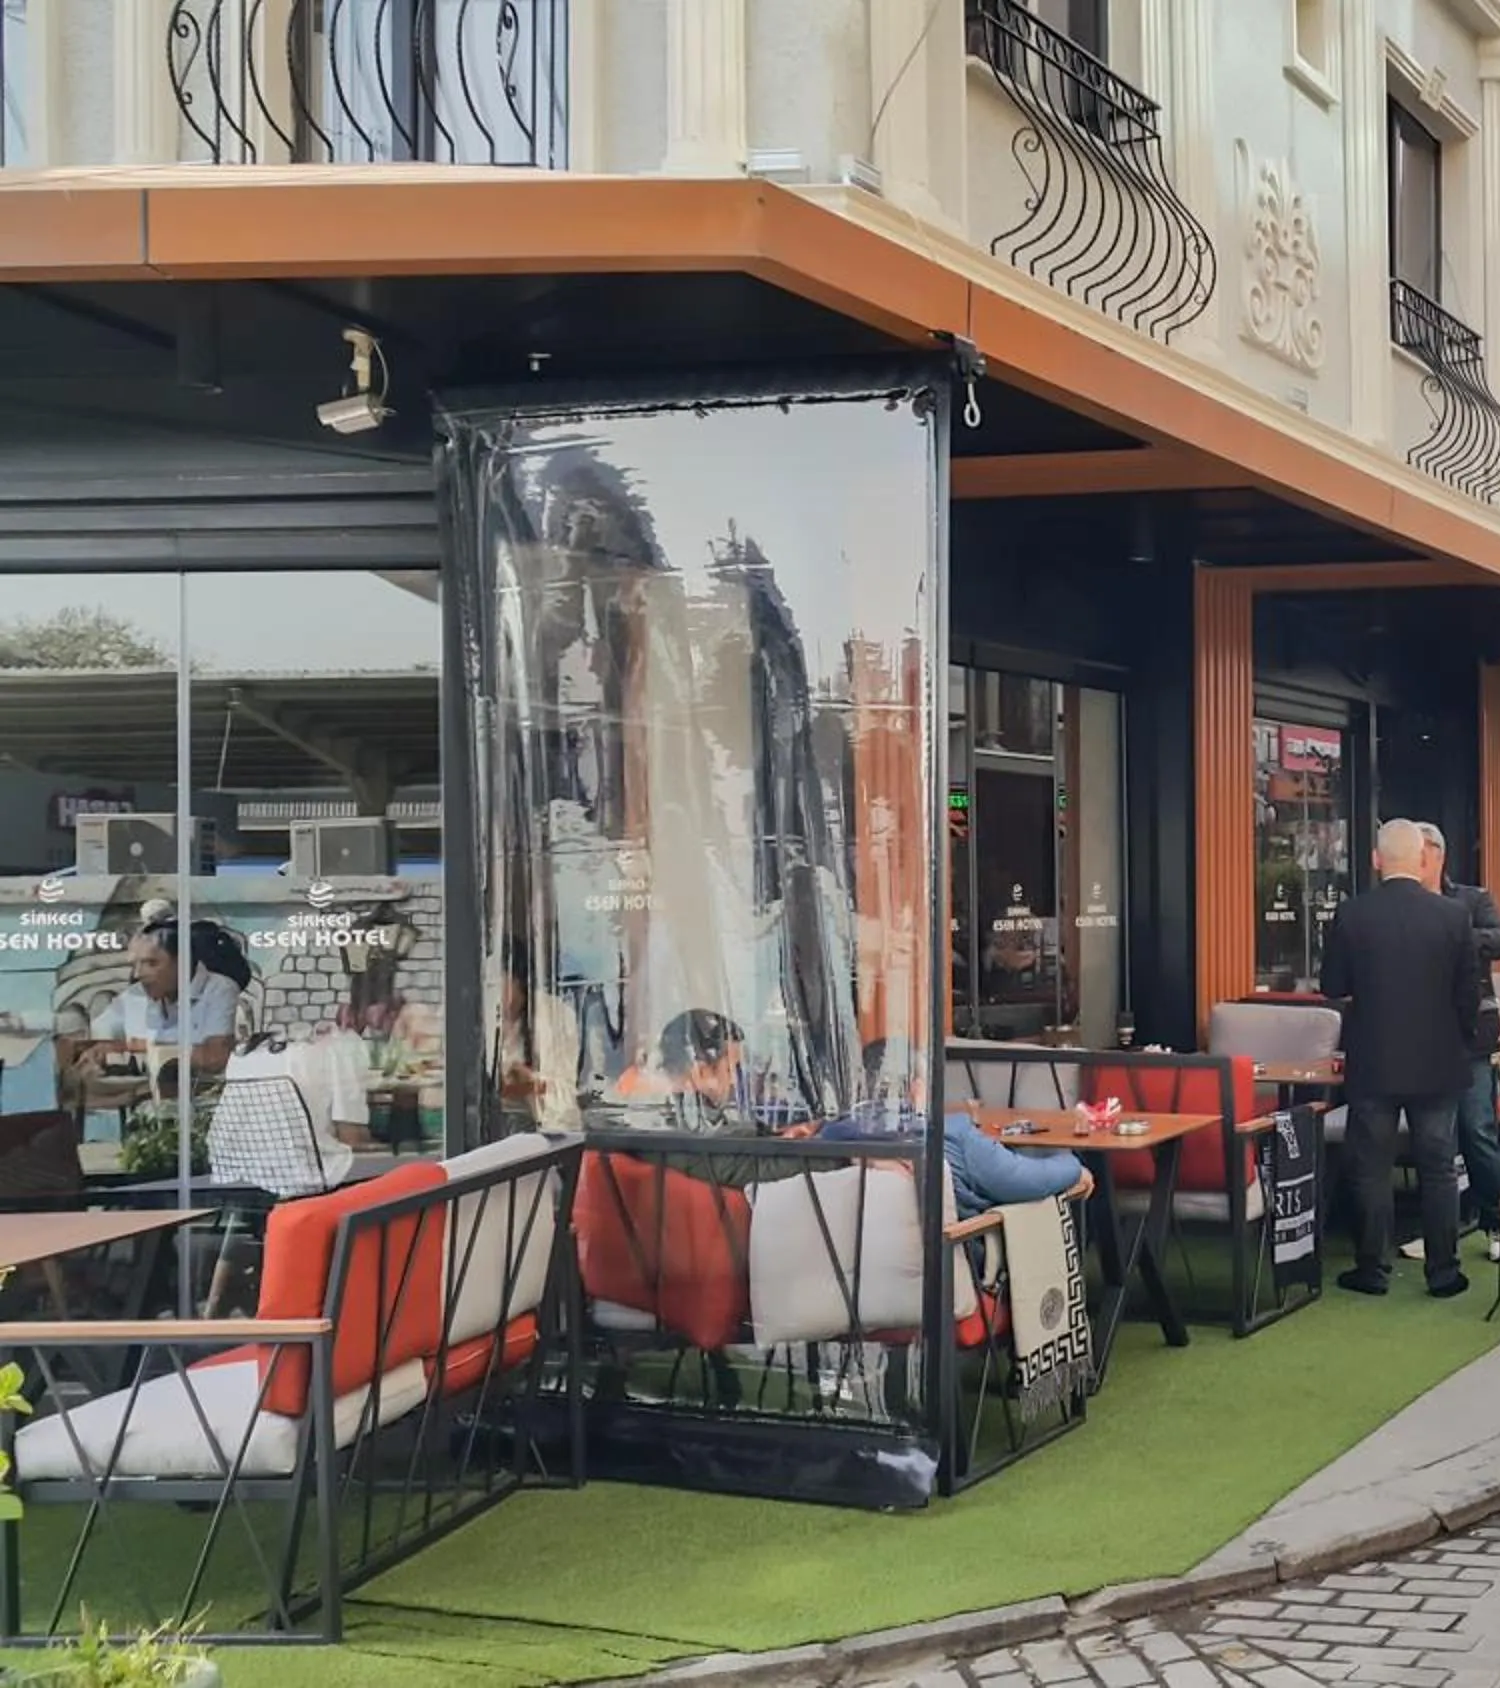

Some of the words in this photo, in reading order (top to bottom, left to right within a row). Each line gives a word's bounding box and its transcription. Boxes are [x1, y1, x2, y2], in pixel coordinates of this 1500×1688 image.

[47, 931, 122, 949] HOTEL
[250, 931, 305, 947] ESEN
[316, 929, 391, 947] HOTEL
